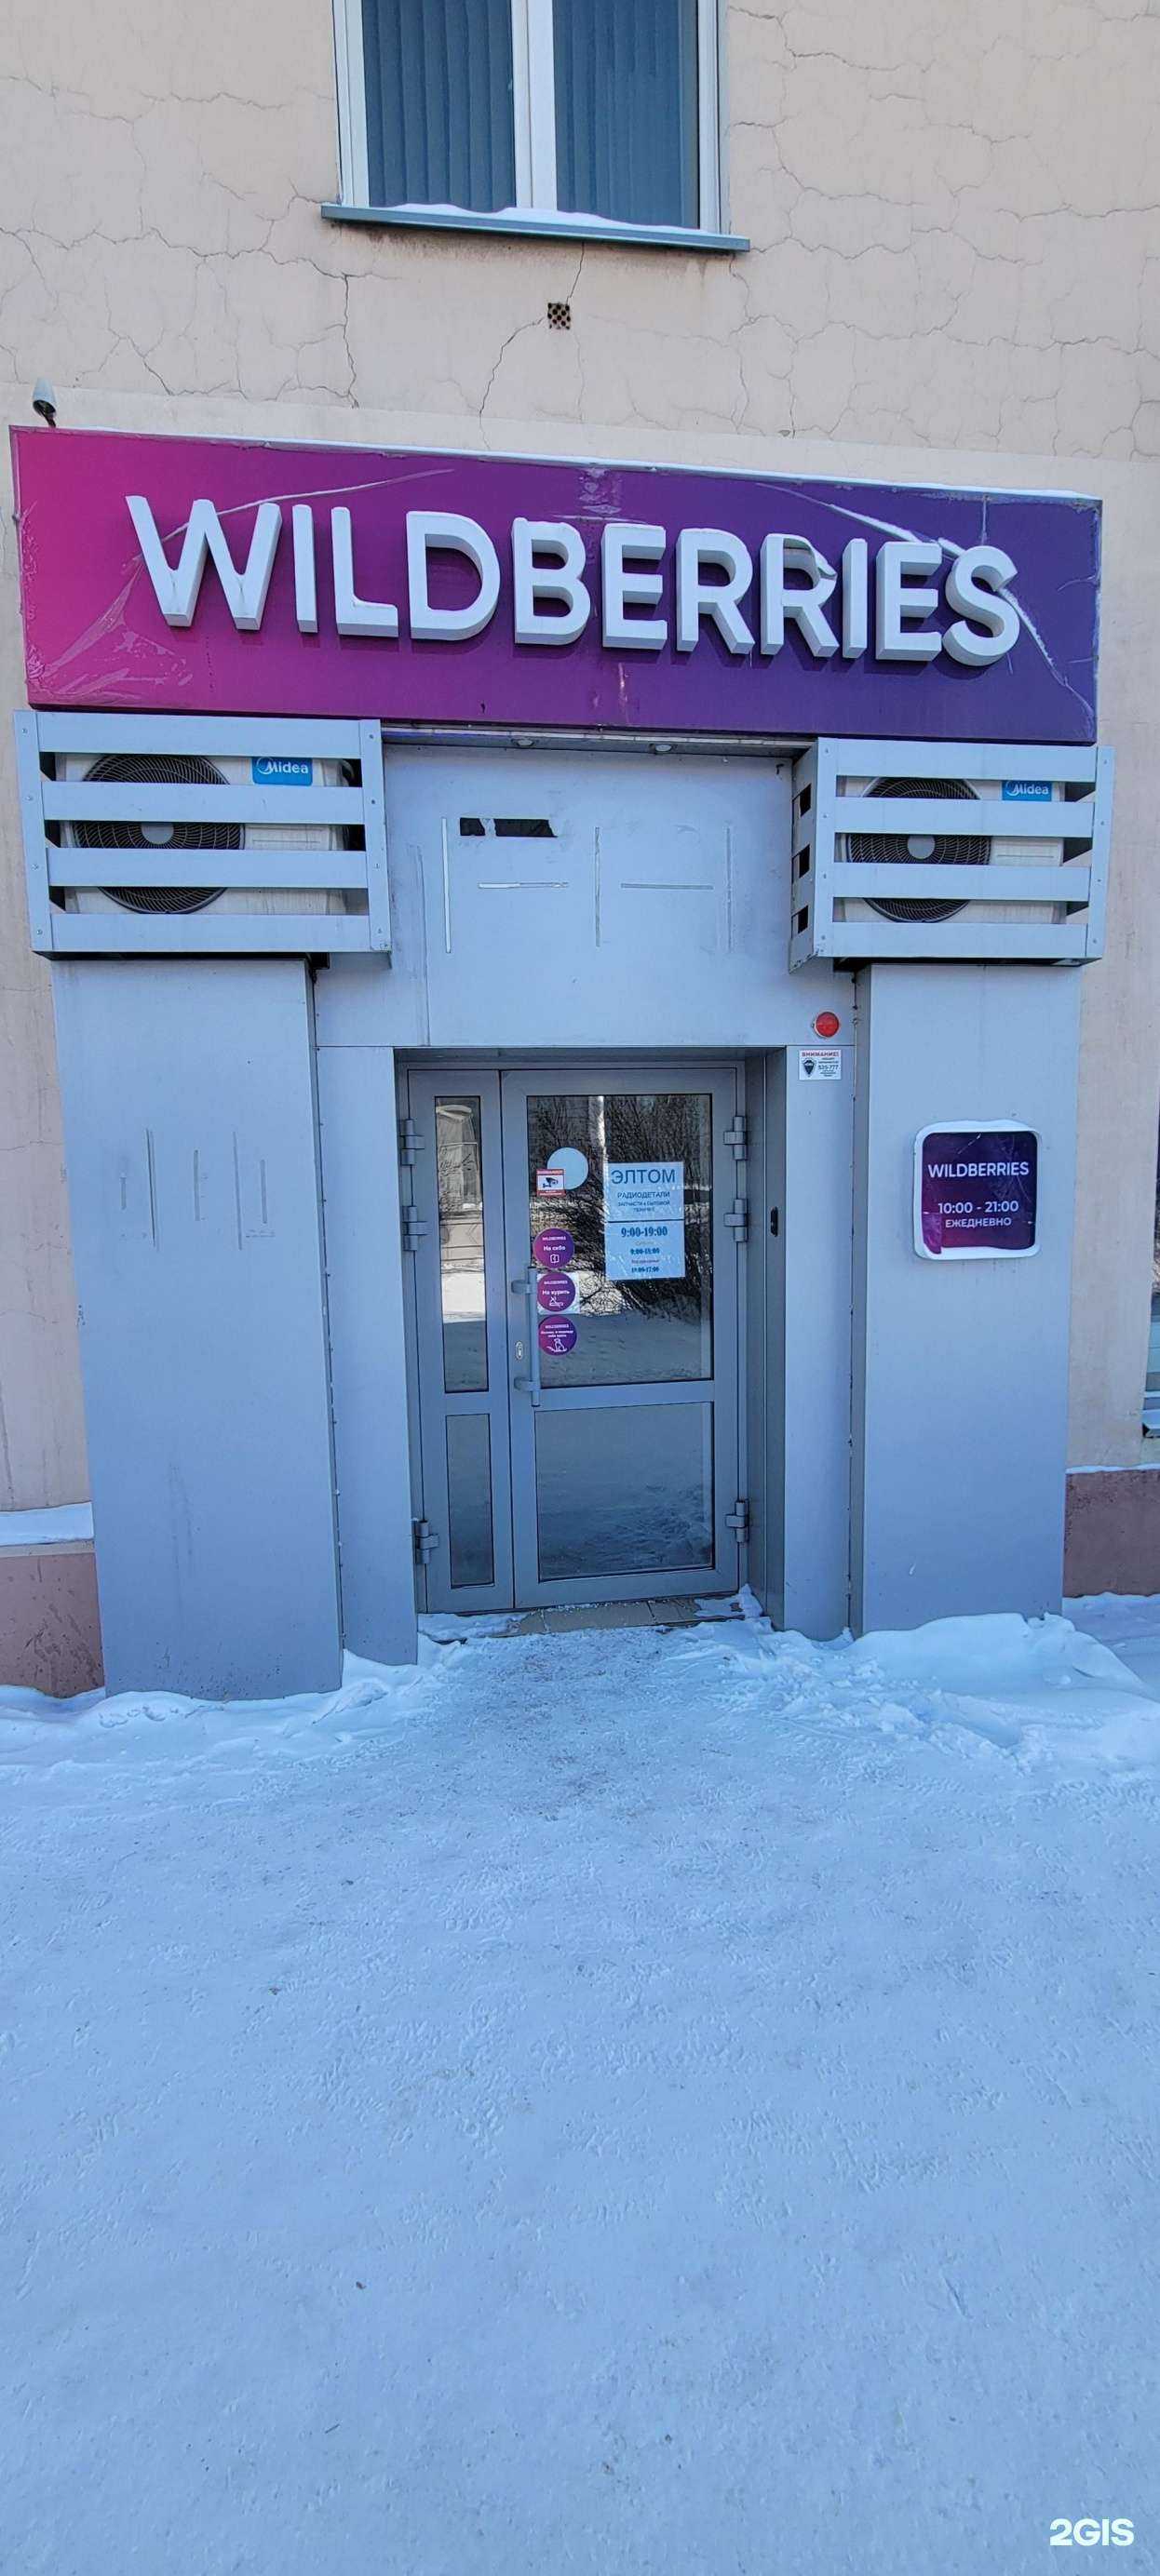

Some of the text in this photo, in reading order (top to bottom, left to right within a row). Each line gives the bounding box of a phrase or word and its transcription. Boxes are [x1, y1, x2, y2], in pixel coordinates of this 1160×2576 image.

[125, 495, 1020, 667] WILDBERRIES
[262, 759, 308, 774] Midea
[1009, 783, 1049, 796] Midea
[611, 1169, 676, 1184] ЭЛТОМ
[928, 1161, 1029, 1178] WILDBERRIES
[937, 1201, 973, 1214] 10:00
[984, 1201, 1019, 1213] 21:00
[945, 1217, 1012, 1228] ЕЖЕДНЕВНО
[621, 1226, 668, 1238] 9:00-19:00
